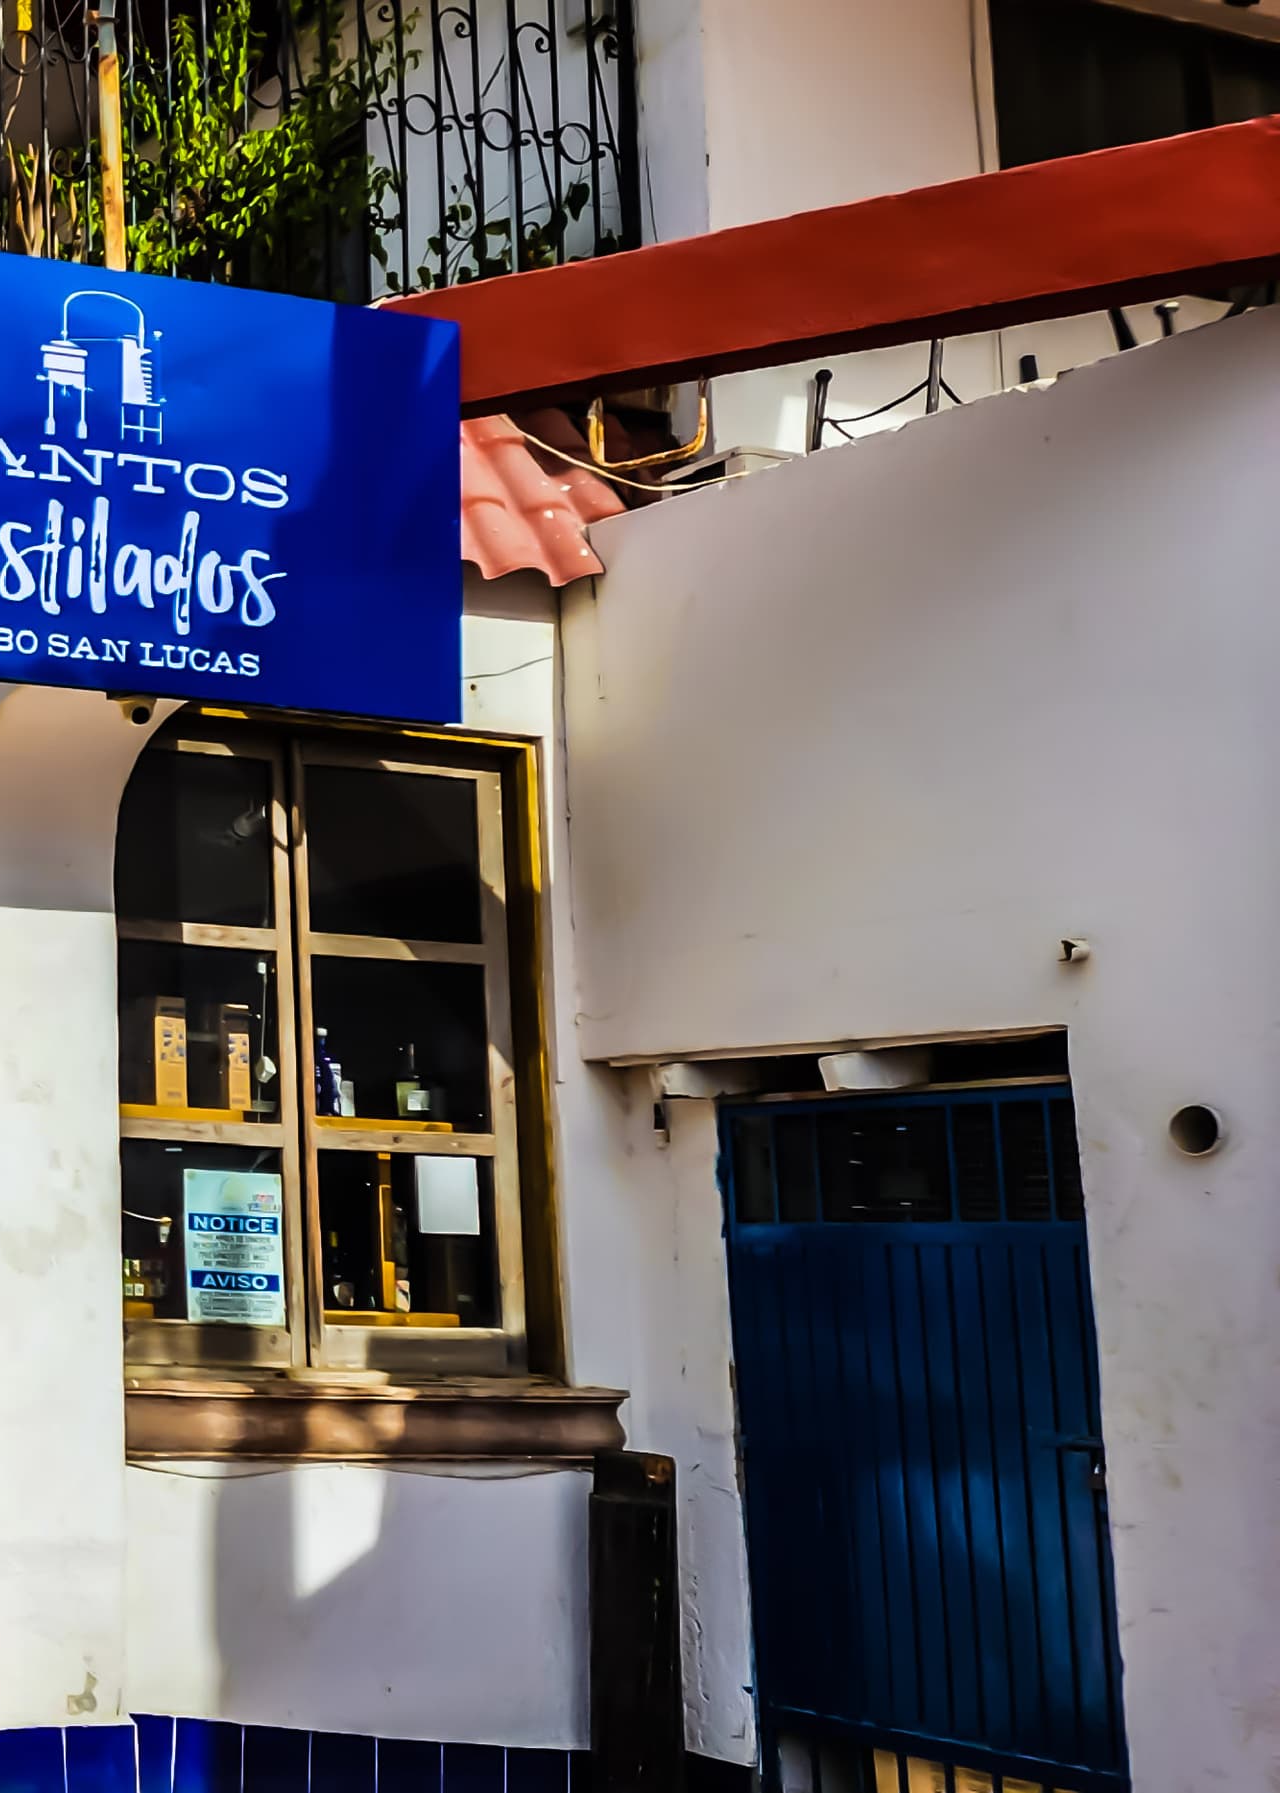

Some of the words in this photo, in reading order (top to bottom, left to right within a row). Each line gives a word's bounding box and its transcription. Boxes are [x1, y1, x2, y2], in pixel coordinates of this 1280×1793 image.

[47, 633, 130, 664] SAN
[140, 642, 261, 678] LUCAS
[193, 1214, 275, 1233] NOTICE
[202, 1273, 269, 1290] AVISO
